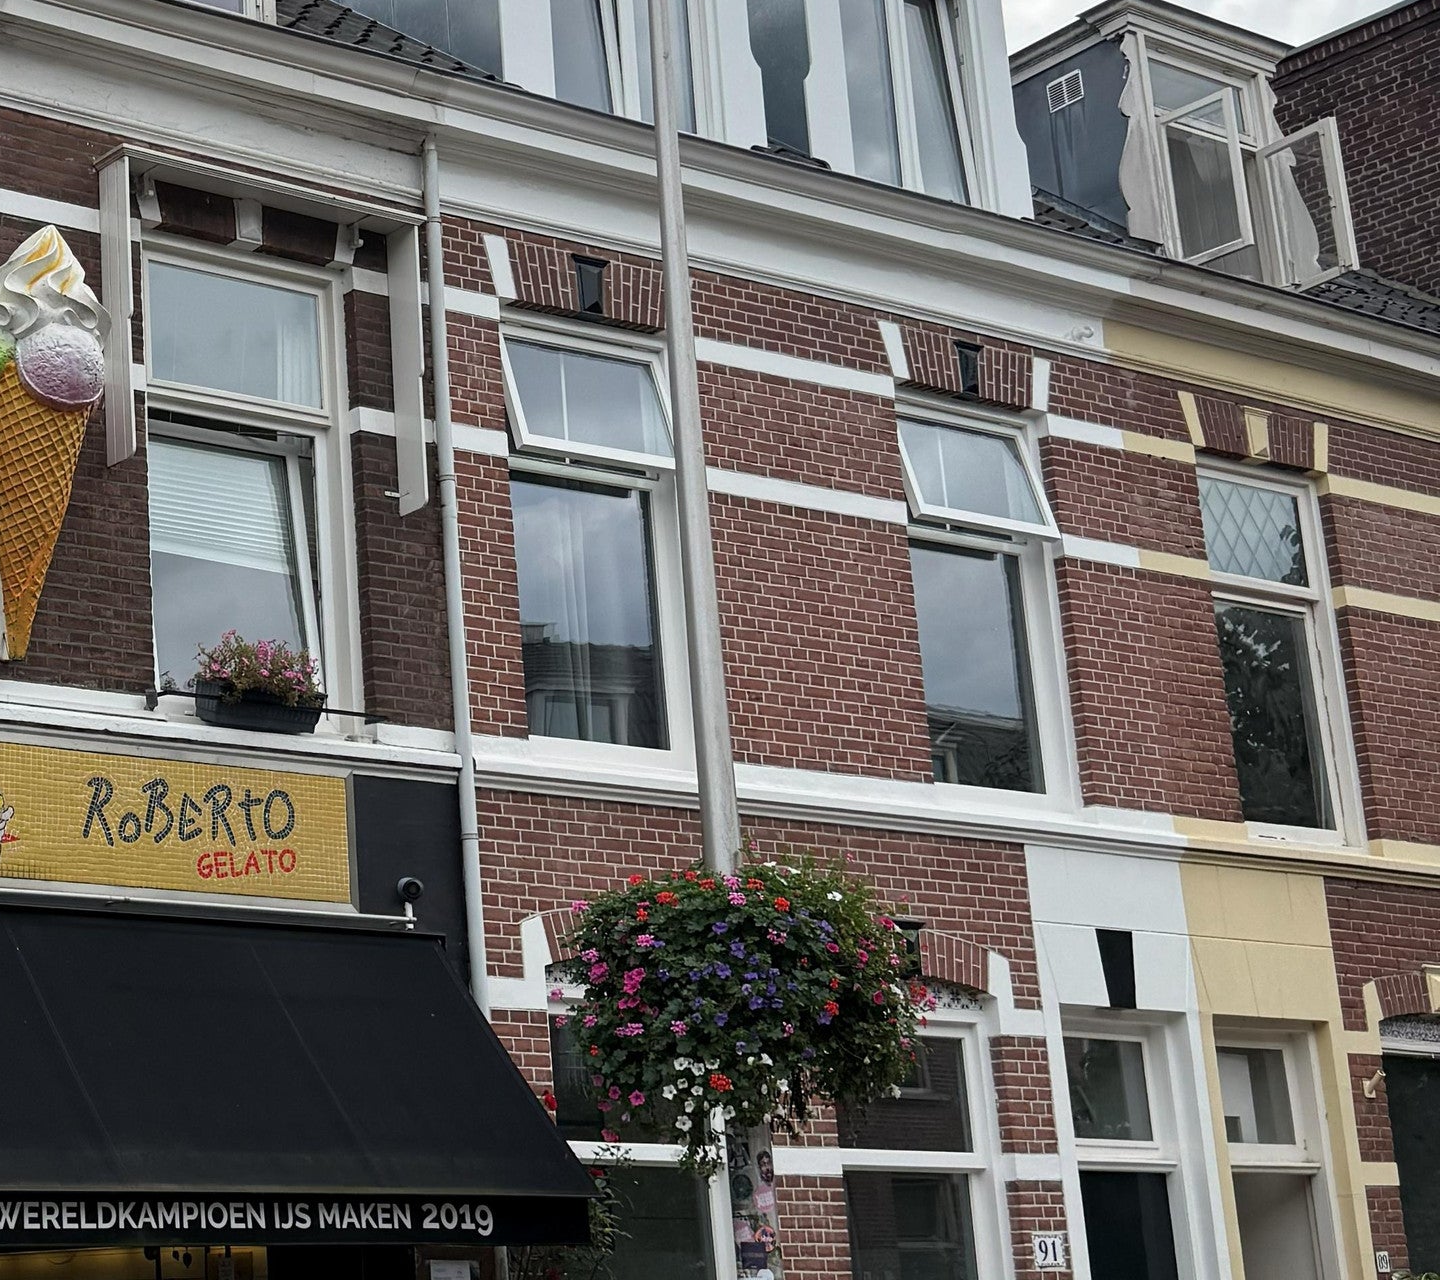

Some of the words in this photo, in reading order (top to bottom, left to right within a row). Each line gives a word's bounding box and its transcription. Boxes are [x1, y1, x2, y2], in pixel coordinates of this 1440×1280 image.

[196, 848, 298, 879] GELATO
[273, 1202, 312, 1231] IJS
[318, 1203, 412, 1232] MAKEN
[421, 1203, 494, 1237] 2019
[1038, 1239, 1058, 1263] 91
